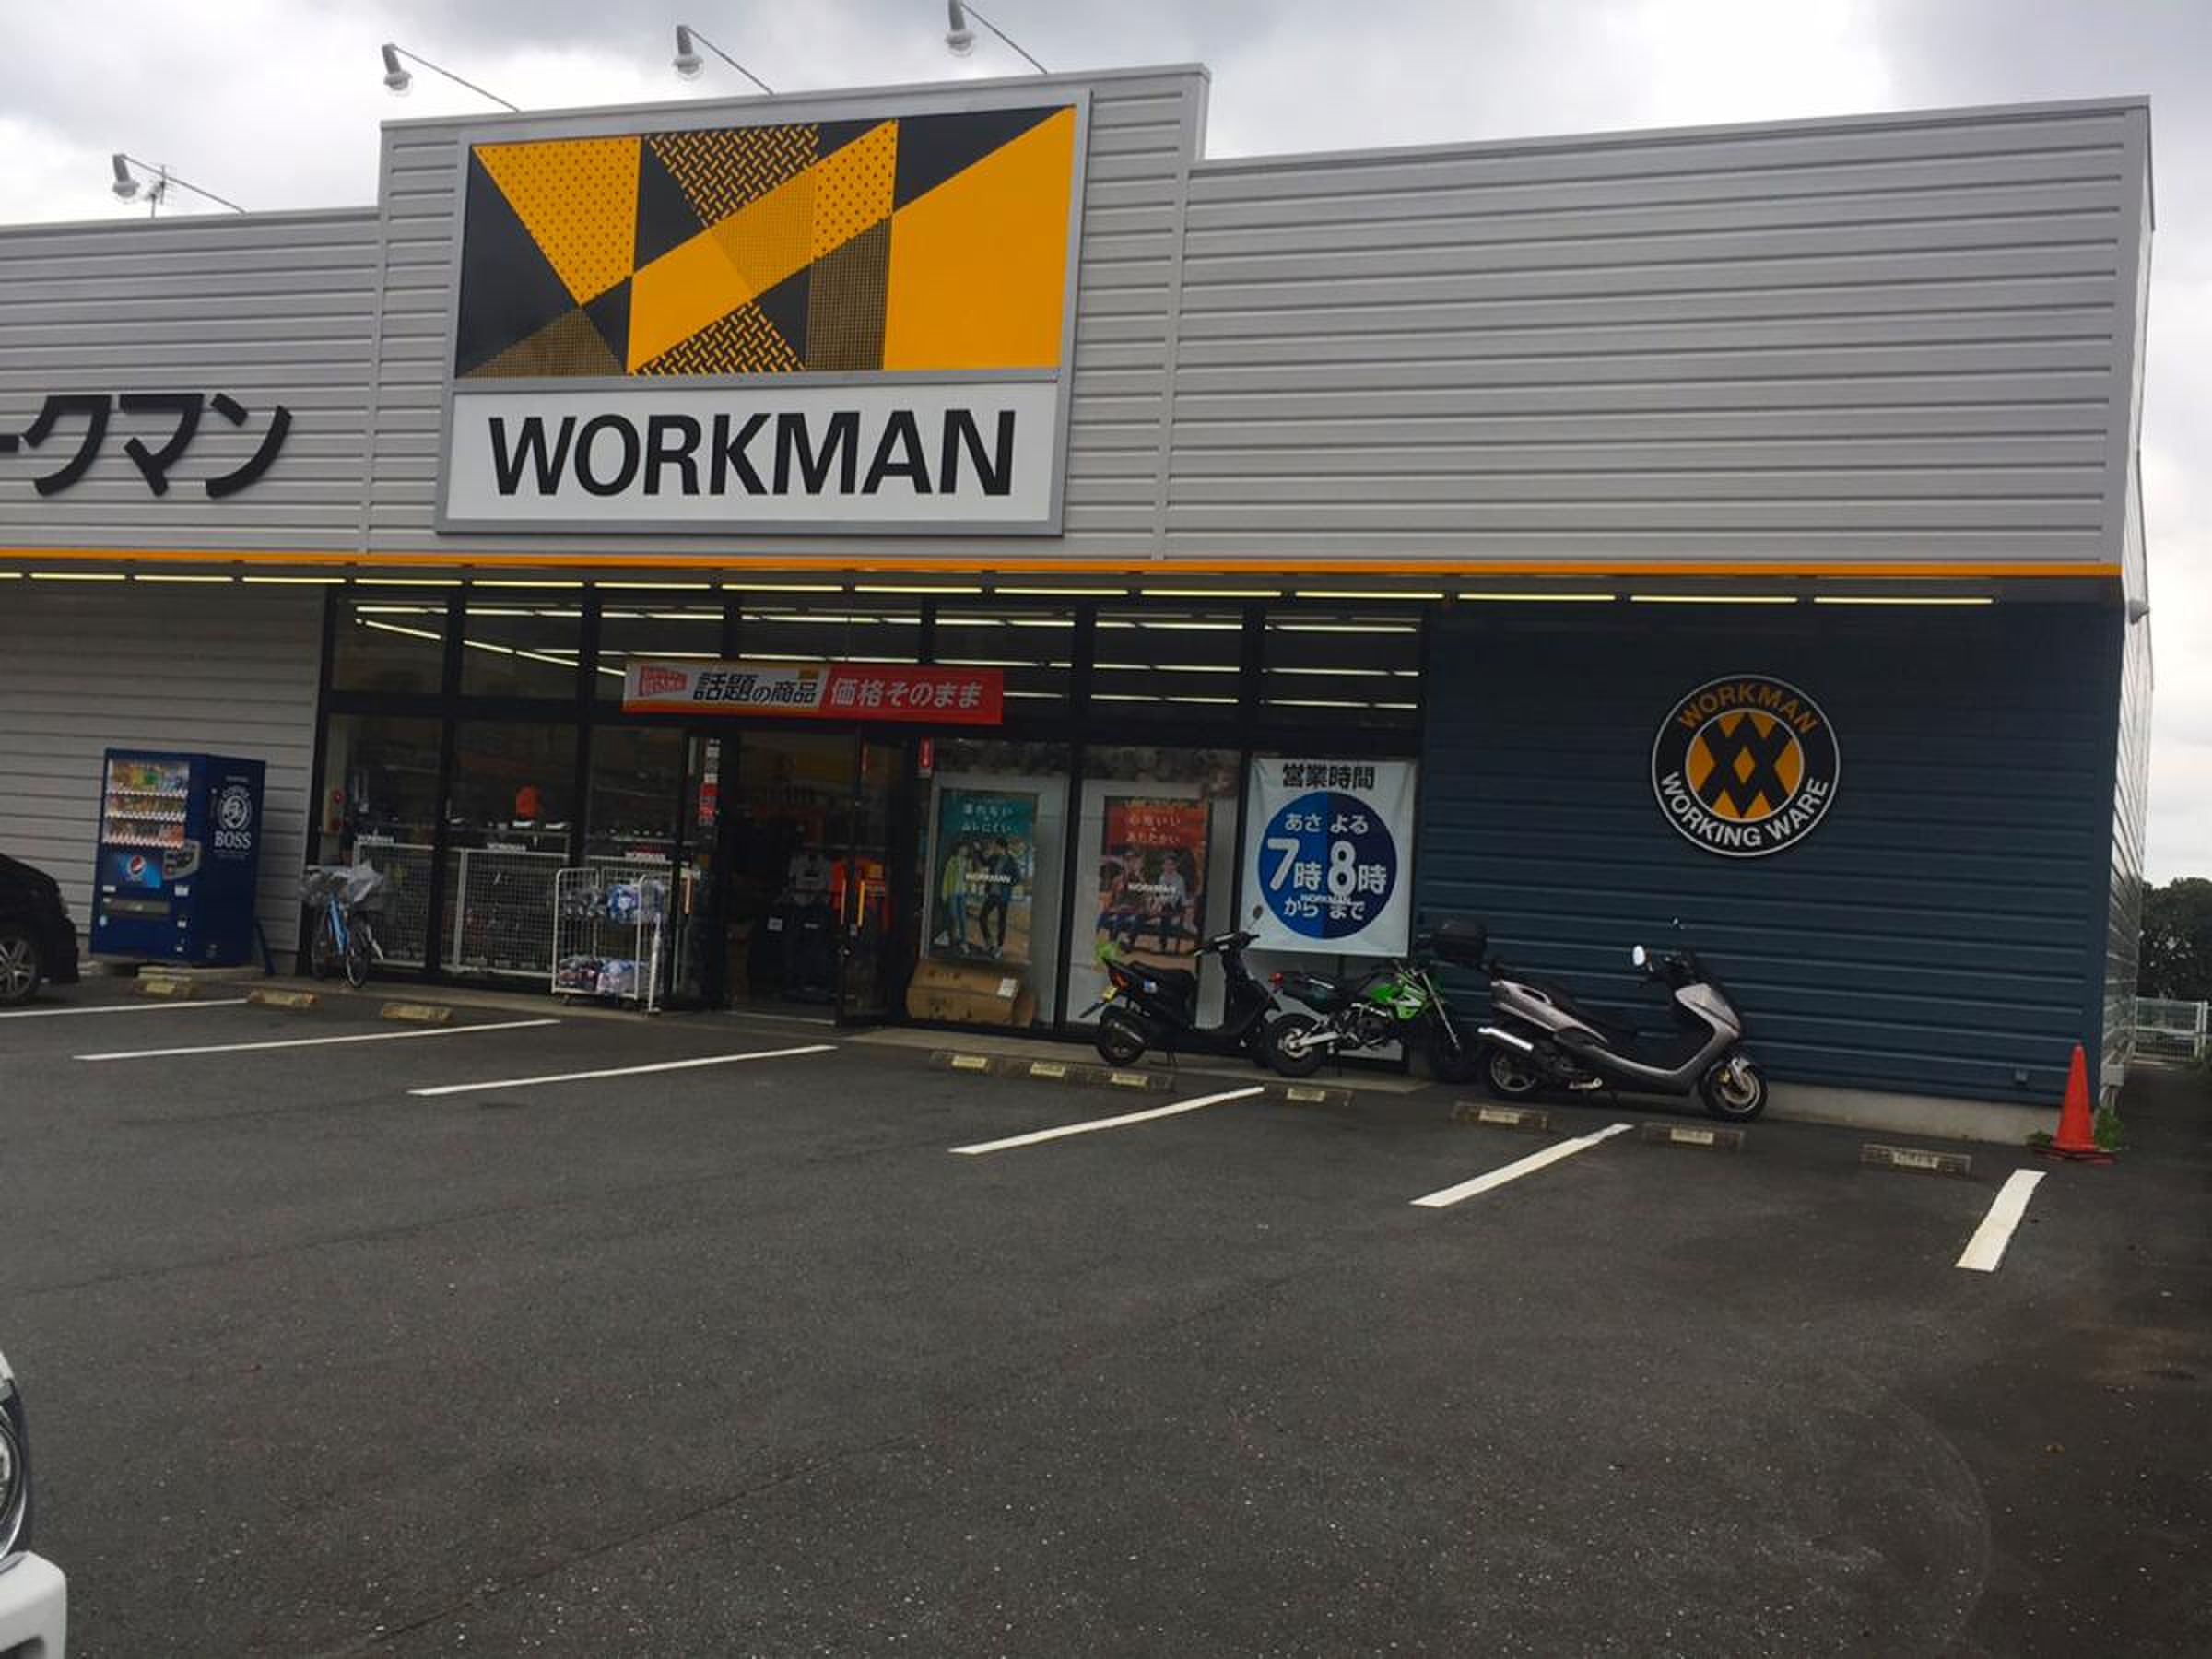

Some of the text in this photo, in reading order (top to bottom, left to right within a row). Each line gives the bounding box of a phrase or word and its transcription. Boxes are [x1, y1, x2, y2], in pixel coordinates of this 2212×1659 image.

[0, 393, 293, 499] クマン
[488, 409, 1016, 497] WORKMAN
[692, 671, 819, 704] 話題の商品
[831, 677, 984, 708] 価格そのまま
[1678, 682, 1818, 734] WORKMAN
[1282, 762, 1375, 790] 営業時間
[1285, 813, 1369, 835] あさ よる
[1661, 771, 1829, 847] WORKING WARE
[214, 830, 251, 848] BOSS
[1267, 838, 1387, 895] 7時 8時
[1284, 896, 1365, 920] から まで
